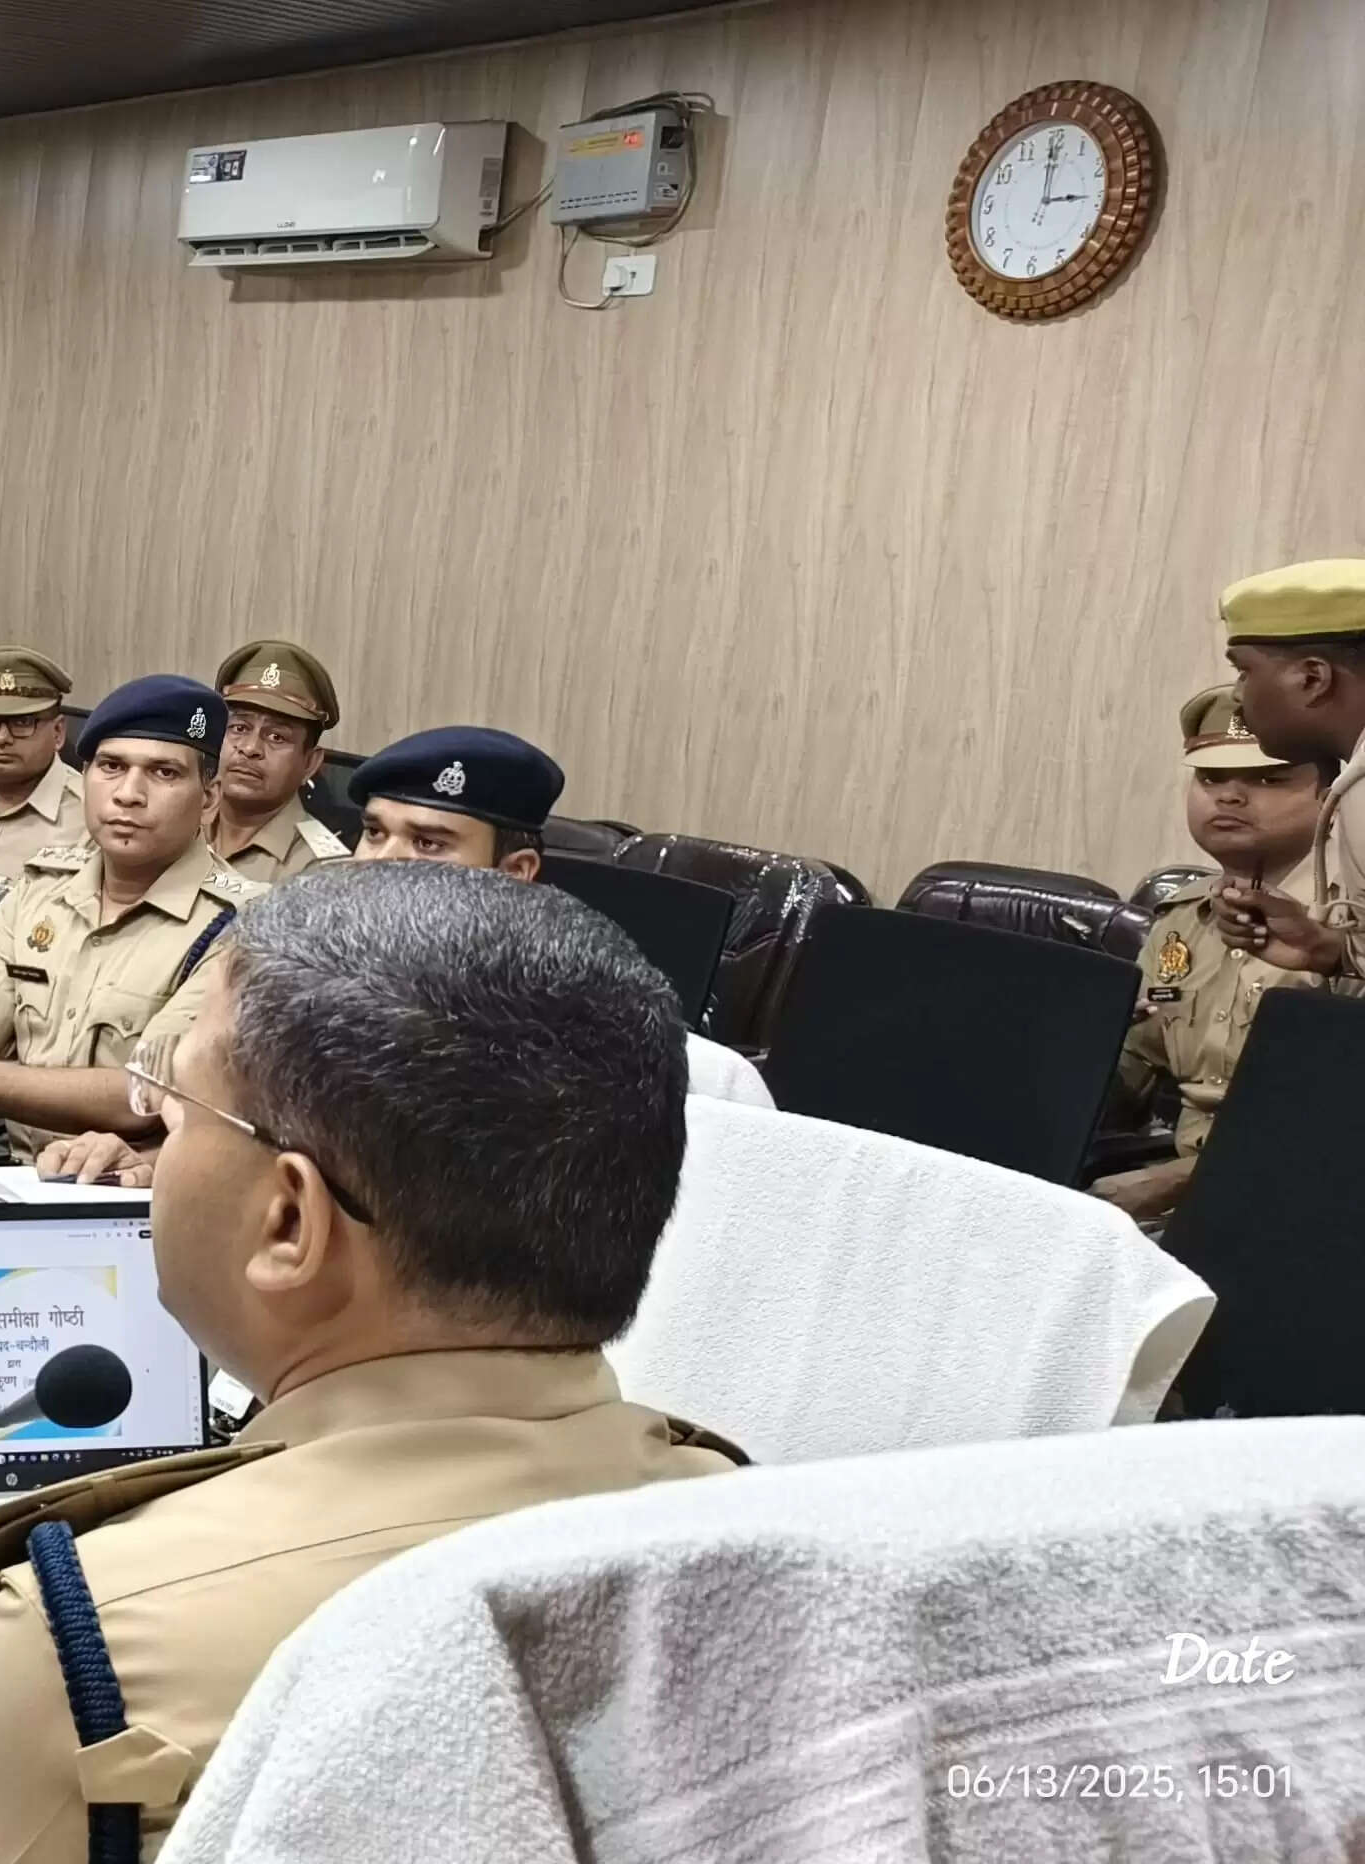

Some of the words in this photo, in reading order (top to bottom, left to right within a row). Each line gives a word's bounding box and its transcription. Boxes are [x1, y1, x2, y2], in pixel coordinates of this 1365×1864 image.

[1018, 140, 1036, 162] 11
[1077, 135, 1086, 157] 1
[996, 163, 1013, 186] 10
[1094, 157, 1105, 178] 2
[982, 194, 994, 216] 9
[984, 226, 996, 248] 8
[1002, 247, 1014, 270] 7
[1026, 255, 1038, 276] 6
[48, 1305, 85, 1328] गोष्ठी
